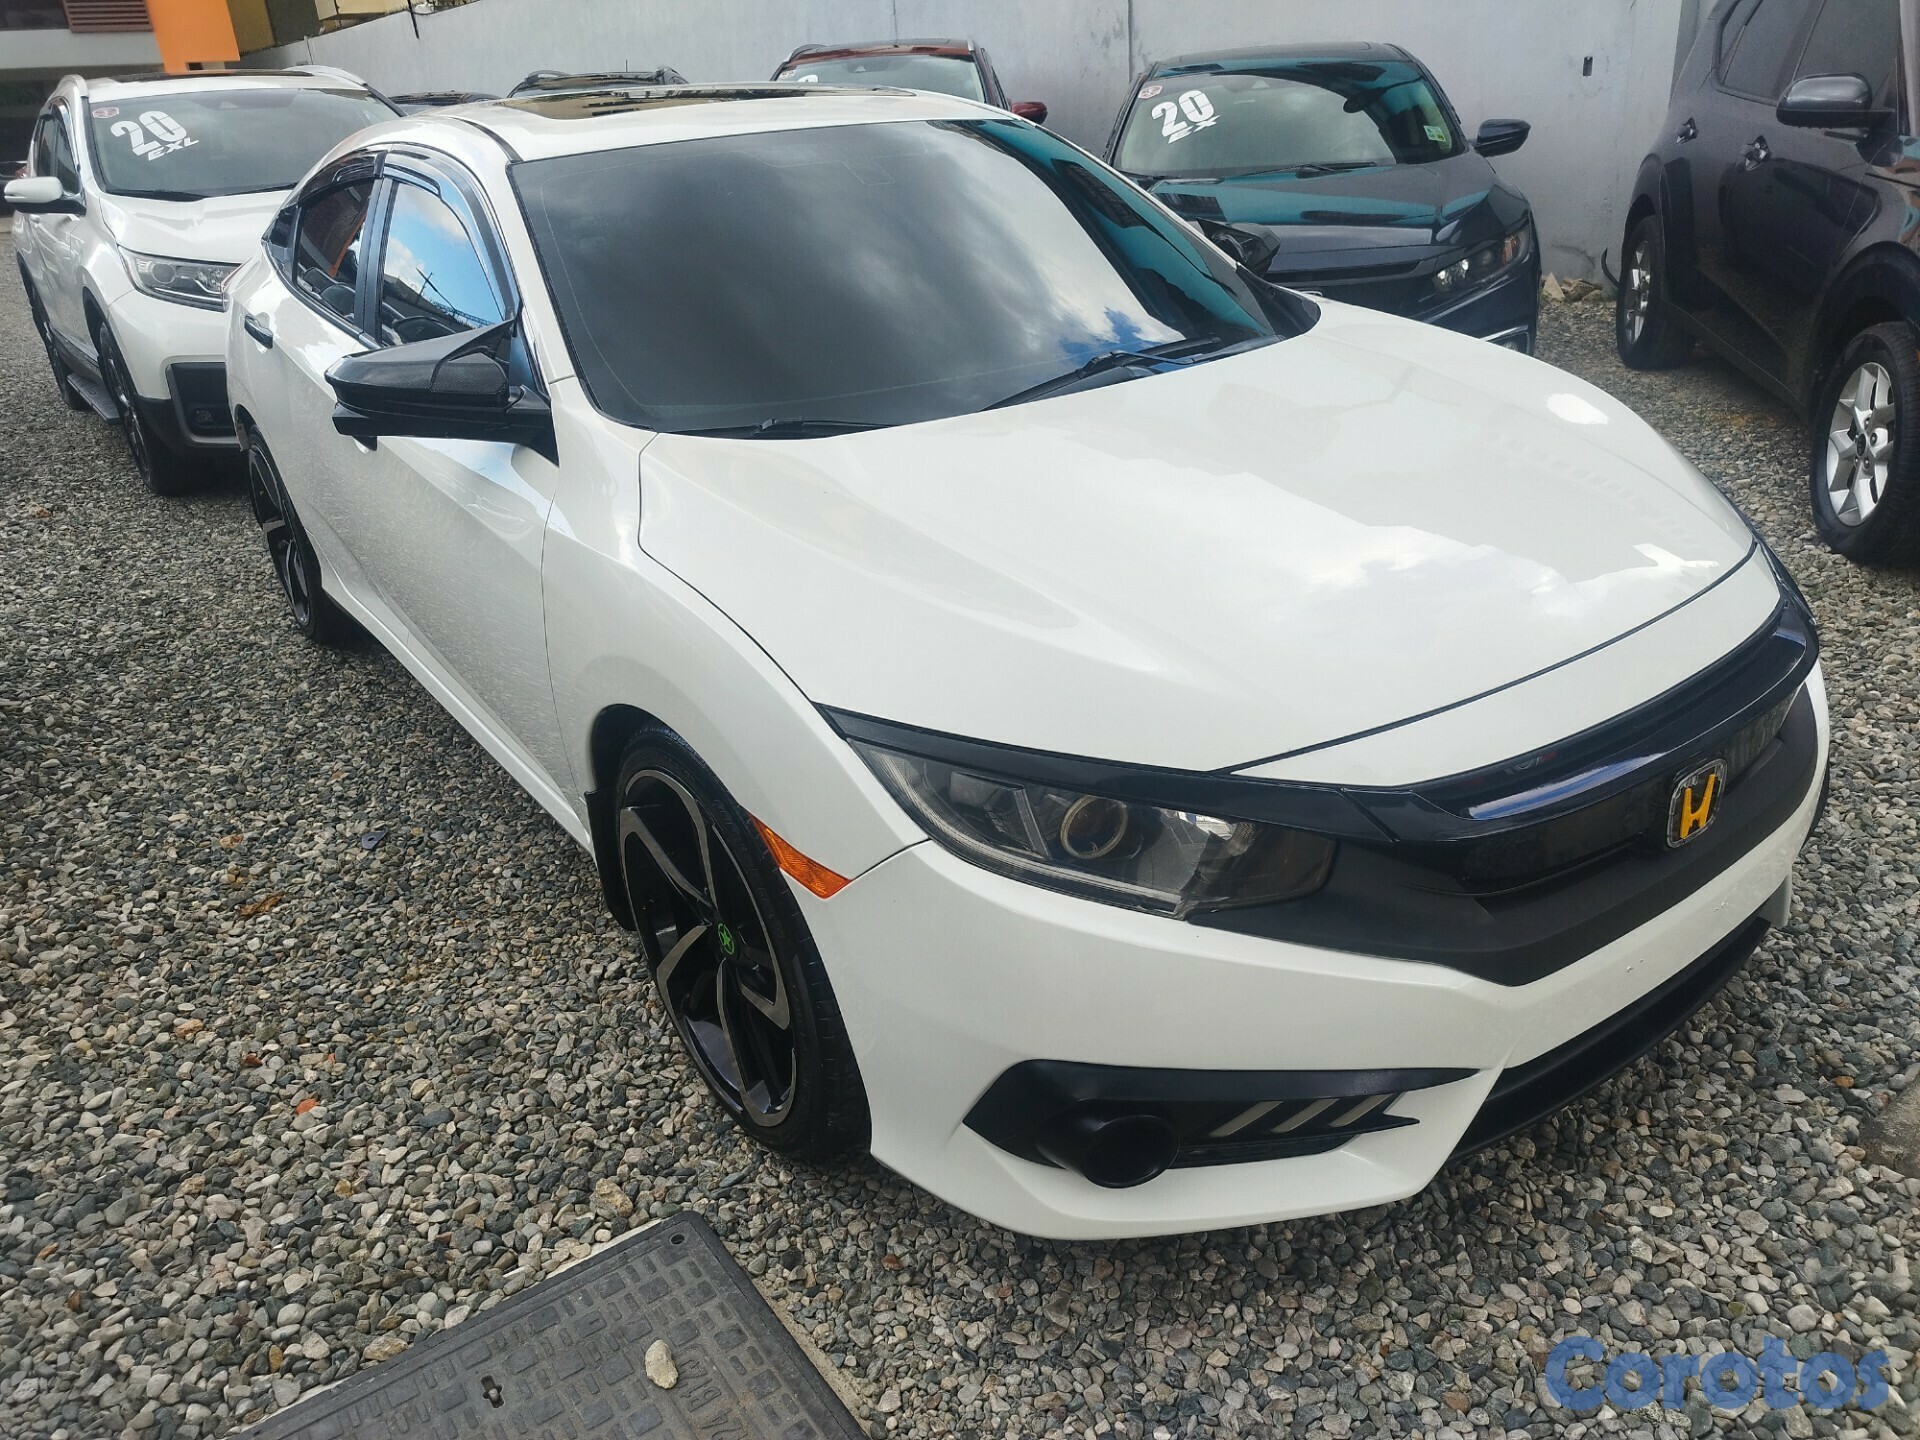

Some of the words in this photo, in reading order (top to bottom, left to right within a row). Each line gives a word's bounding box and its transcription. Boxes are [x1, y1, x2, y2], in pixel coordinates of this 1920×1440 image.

[1151, 90, 1214, 137] 20
[1167, 115, 1220, 144] EX
[110, 110, 187, 156] 20
[147, 137, 199, 161] EXL
